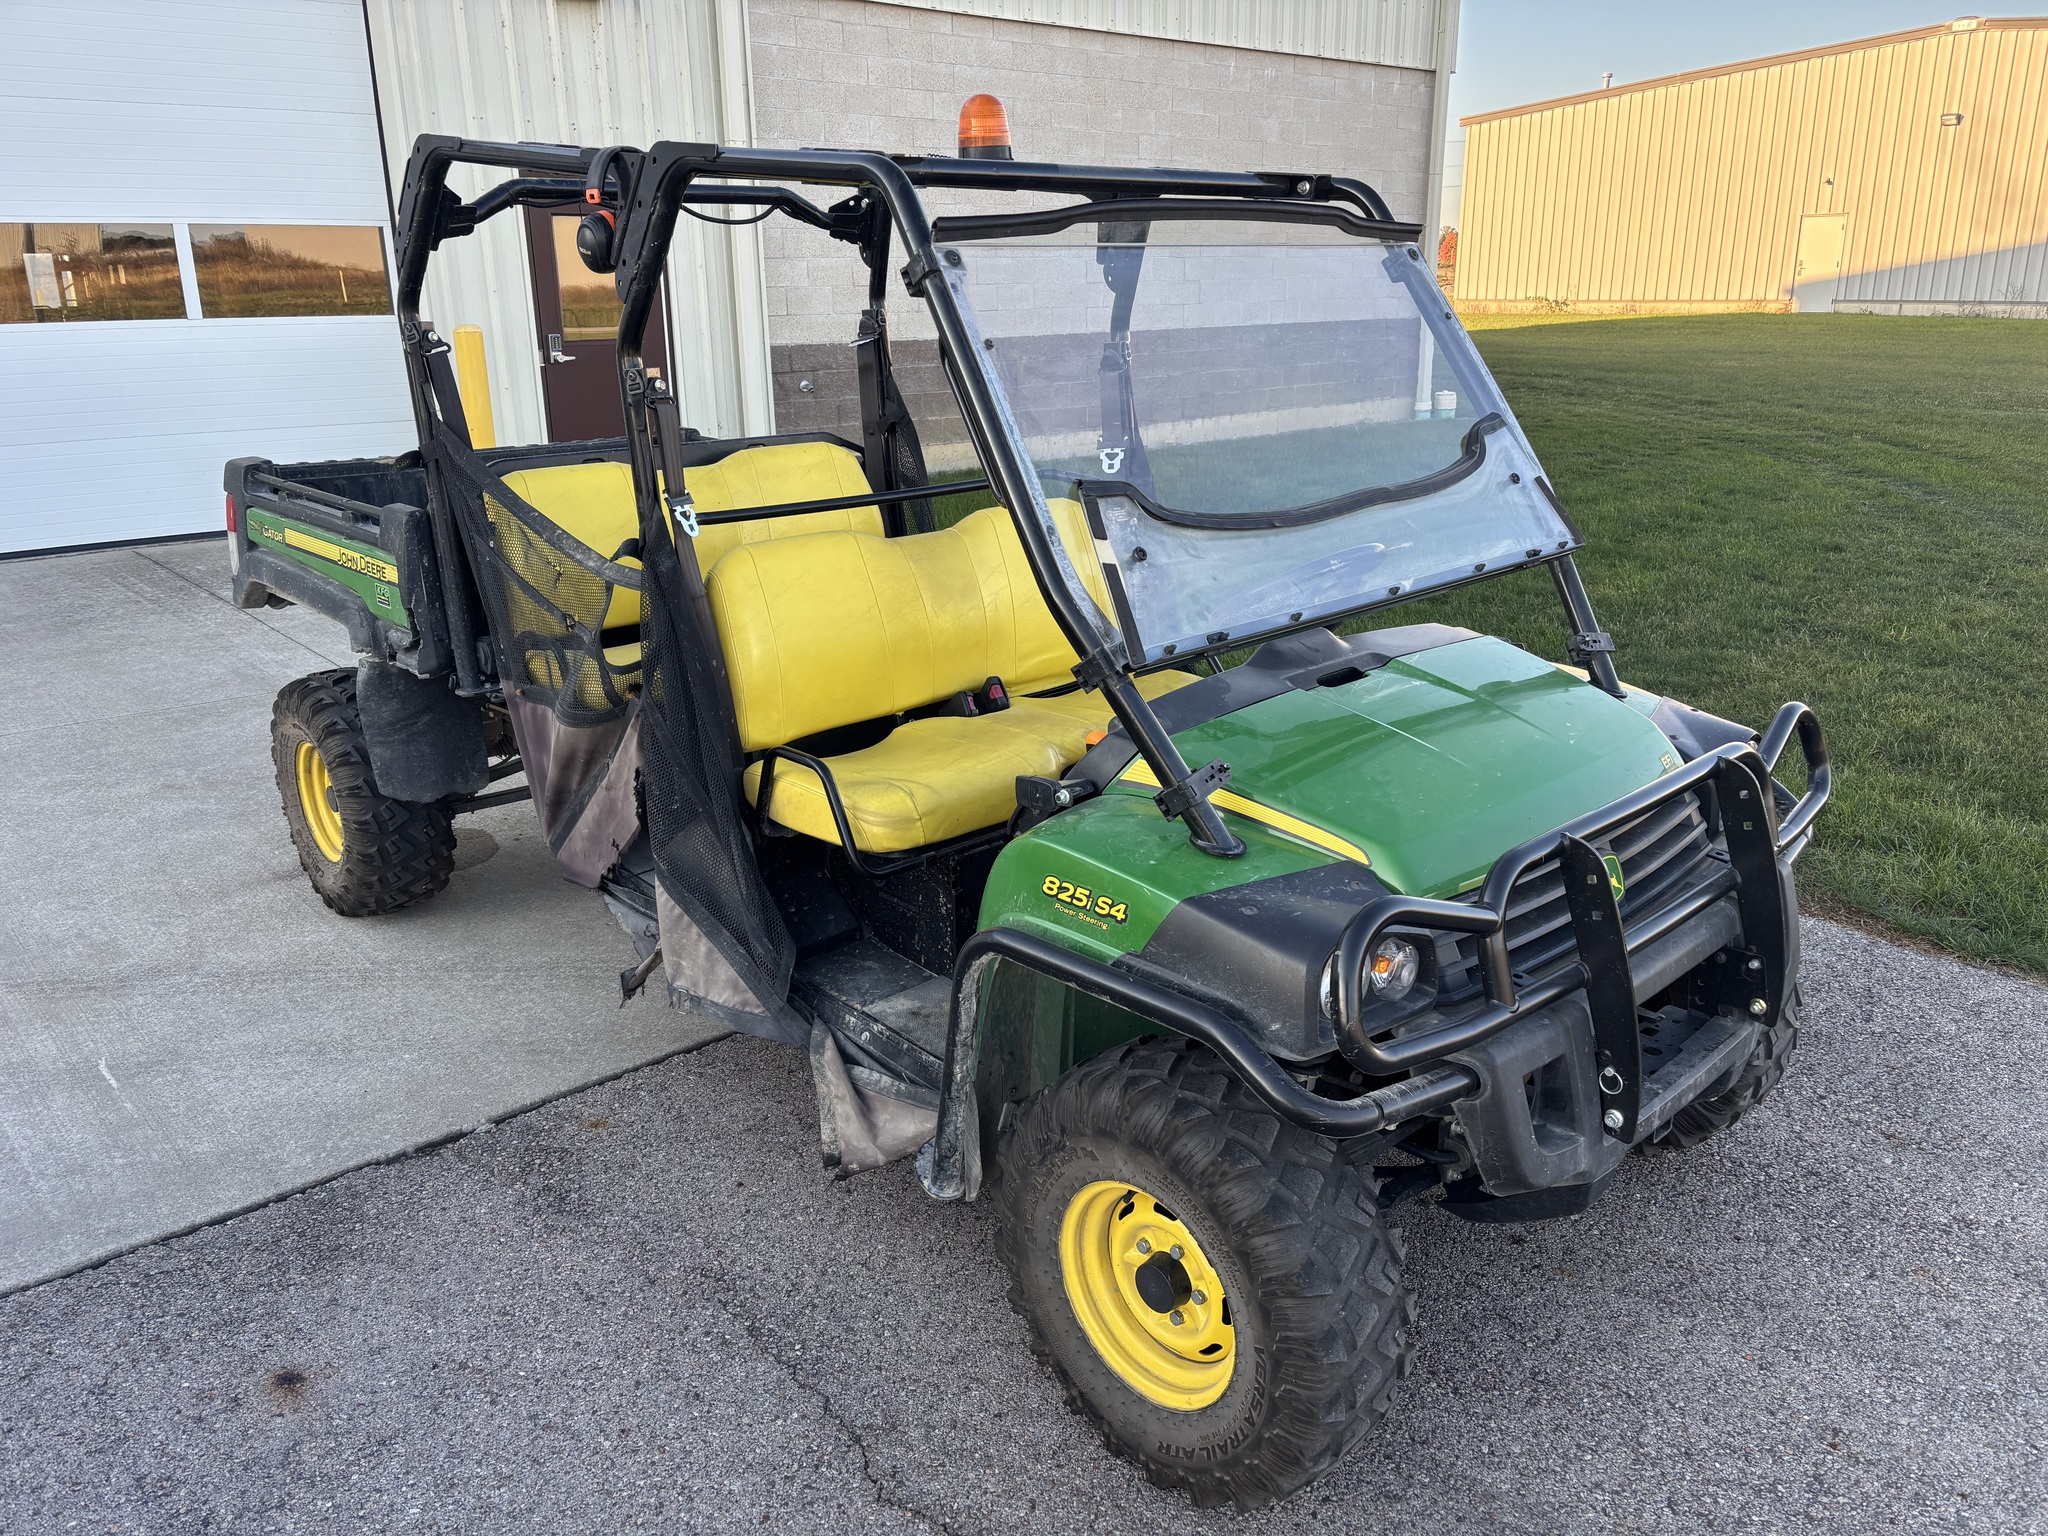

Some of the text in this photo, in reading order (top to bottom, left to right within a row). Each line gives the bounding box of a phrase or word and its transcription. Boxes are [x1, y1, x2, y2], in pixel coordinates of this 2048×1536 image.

[262, 526, 283, 542] GATOR
[337, 548, 386, 579] JOHN DEERE
[1042, 875, 1128, 922] 825i S4
[1054, 902, 1110, 930] Power Steering
[1157, 1345, 1268, 1461] VERSA TRAIL ATR
